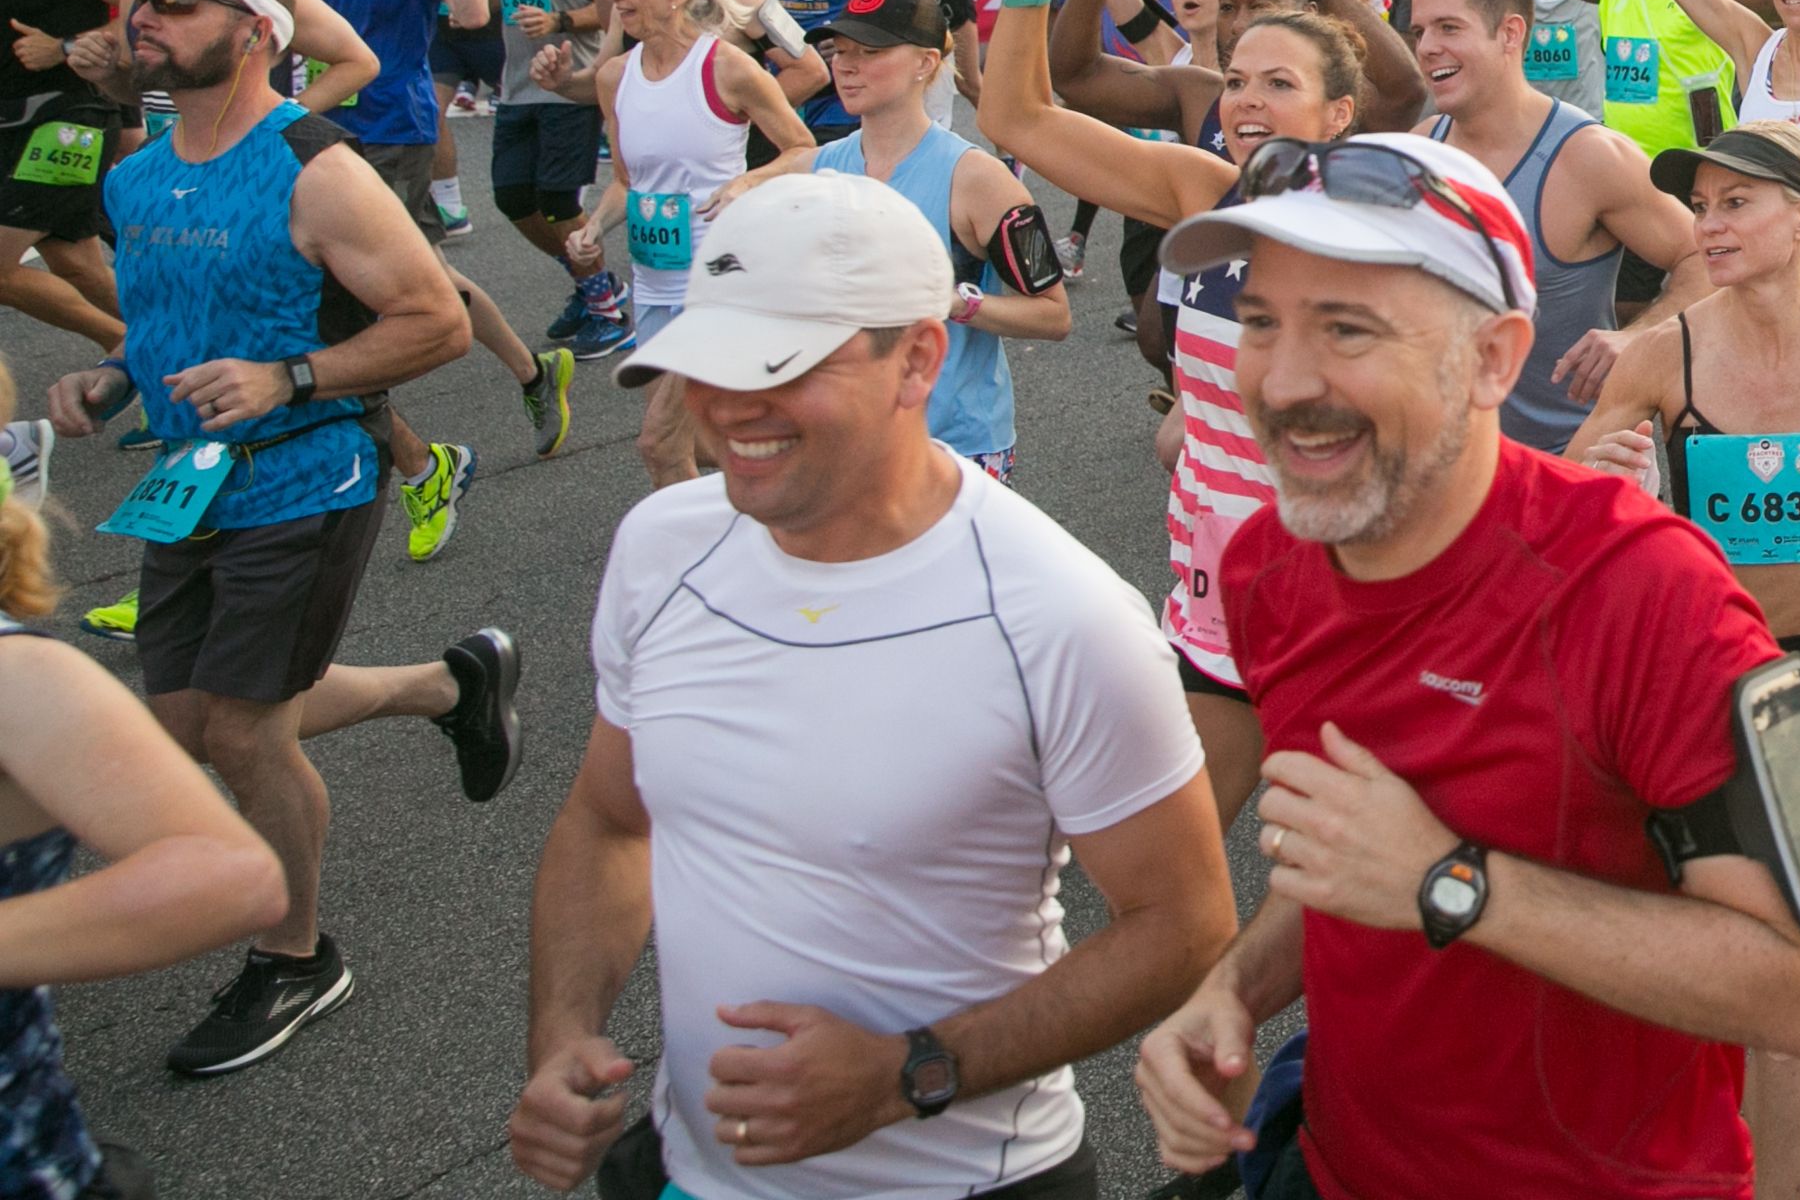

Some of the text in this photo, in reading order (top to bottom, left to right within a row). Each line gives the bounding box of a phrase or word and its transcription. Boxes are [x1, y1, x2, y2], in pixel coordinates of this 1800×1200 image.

[1534, 49, 1571, 64] 8060
[1613, 65, 1650, 83] 7734
[29, 147, 93, 171] B 4572
[149, 226, 230, 249] ATLANTA
[631, 223, 680, 246] C 6601
[1707, 493, 1731, 523] C
[1193, 568, 1209, 599] D
[1419, 669, 1484, 698] saucony
